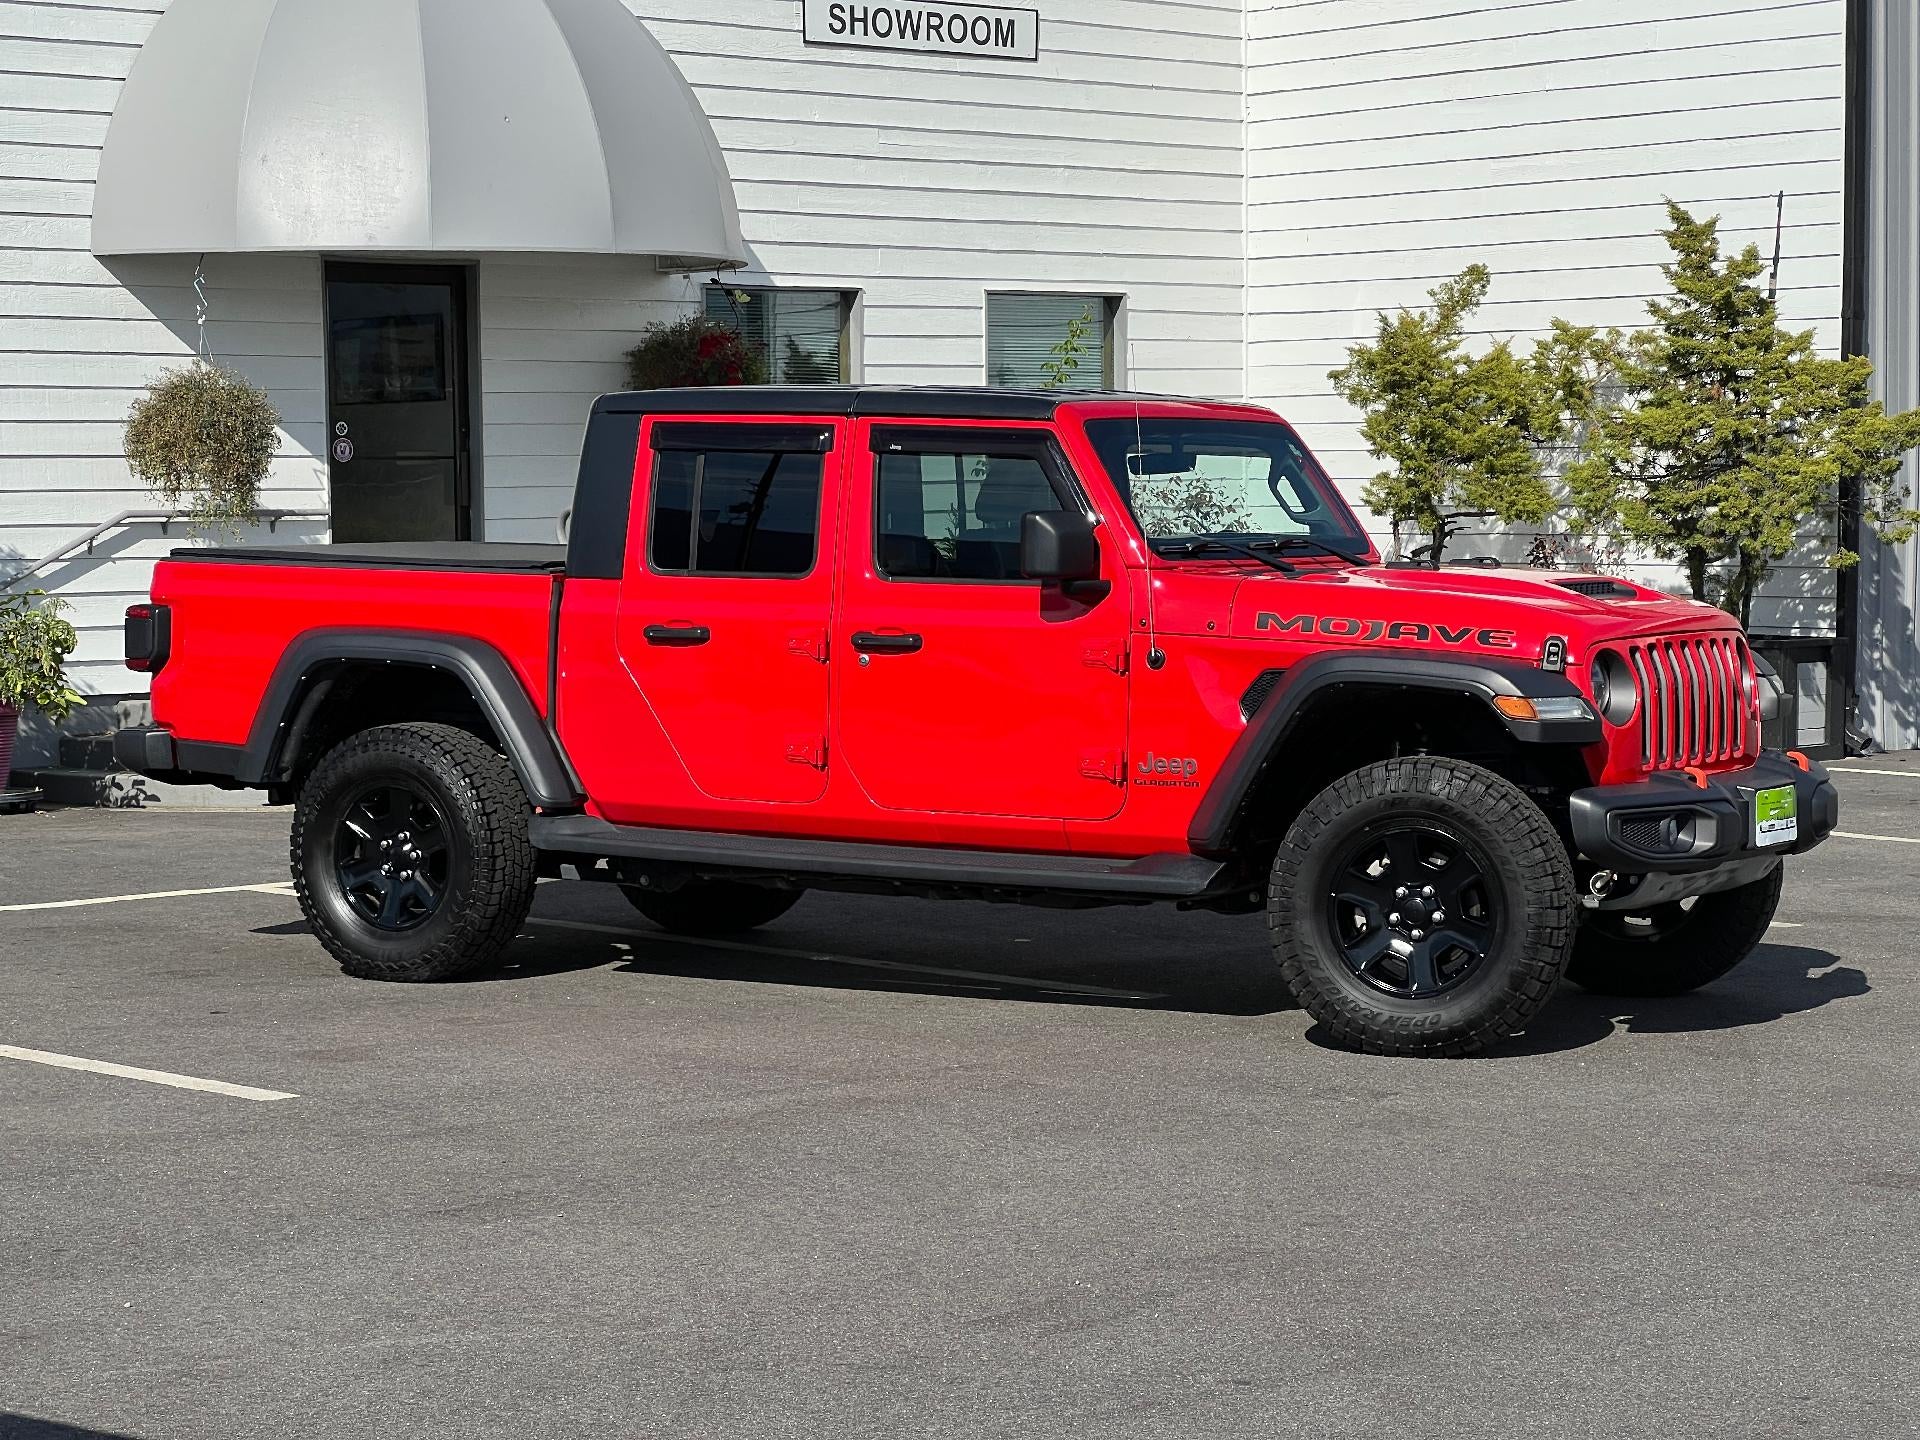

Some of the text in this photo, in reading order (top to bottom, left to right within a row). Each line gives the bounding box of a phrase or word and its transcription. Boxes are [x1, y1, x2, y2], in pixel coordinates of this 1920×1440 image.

[828, 3, 1015, 48] SHOWROOM
[1256, 611, 1517, 648] MOJAVE
[1137, 751, 1198, 779] Jeep
[1134, 779, 1200, 788] GLADIATOR
[1383, 1014, 1441, 1029] OPEN
